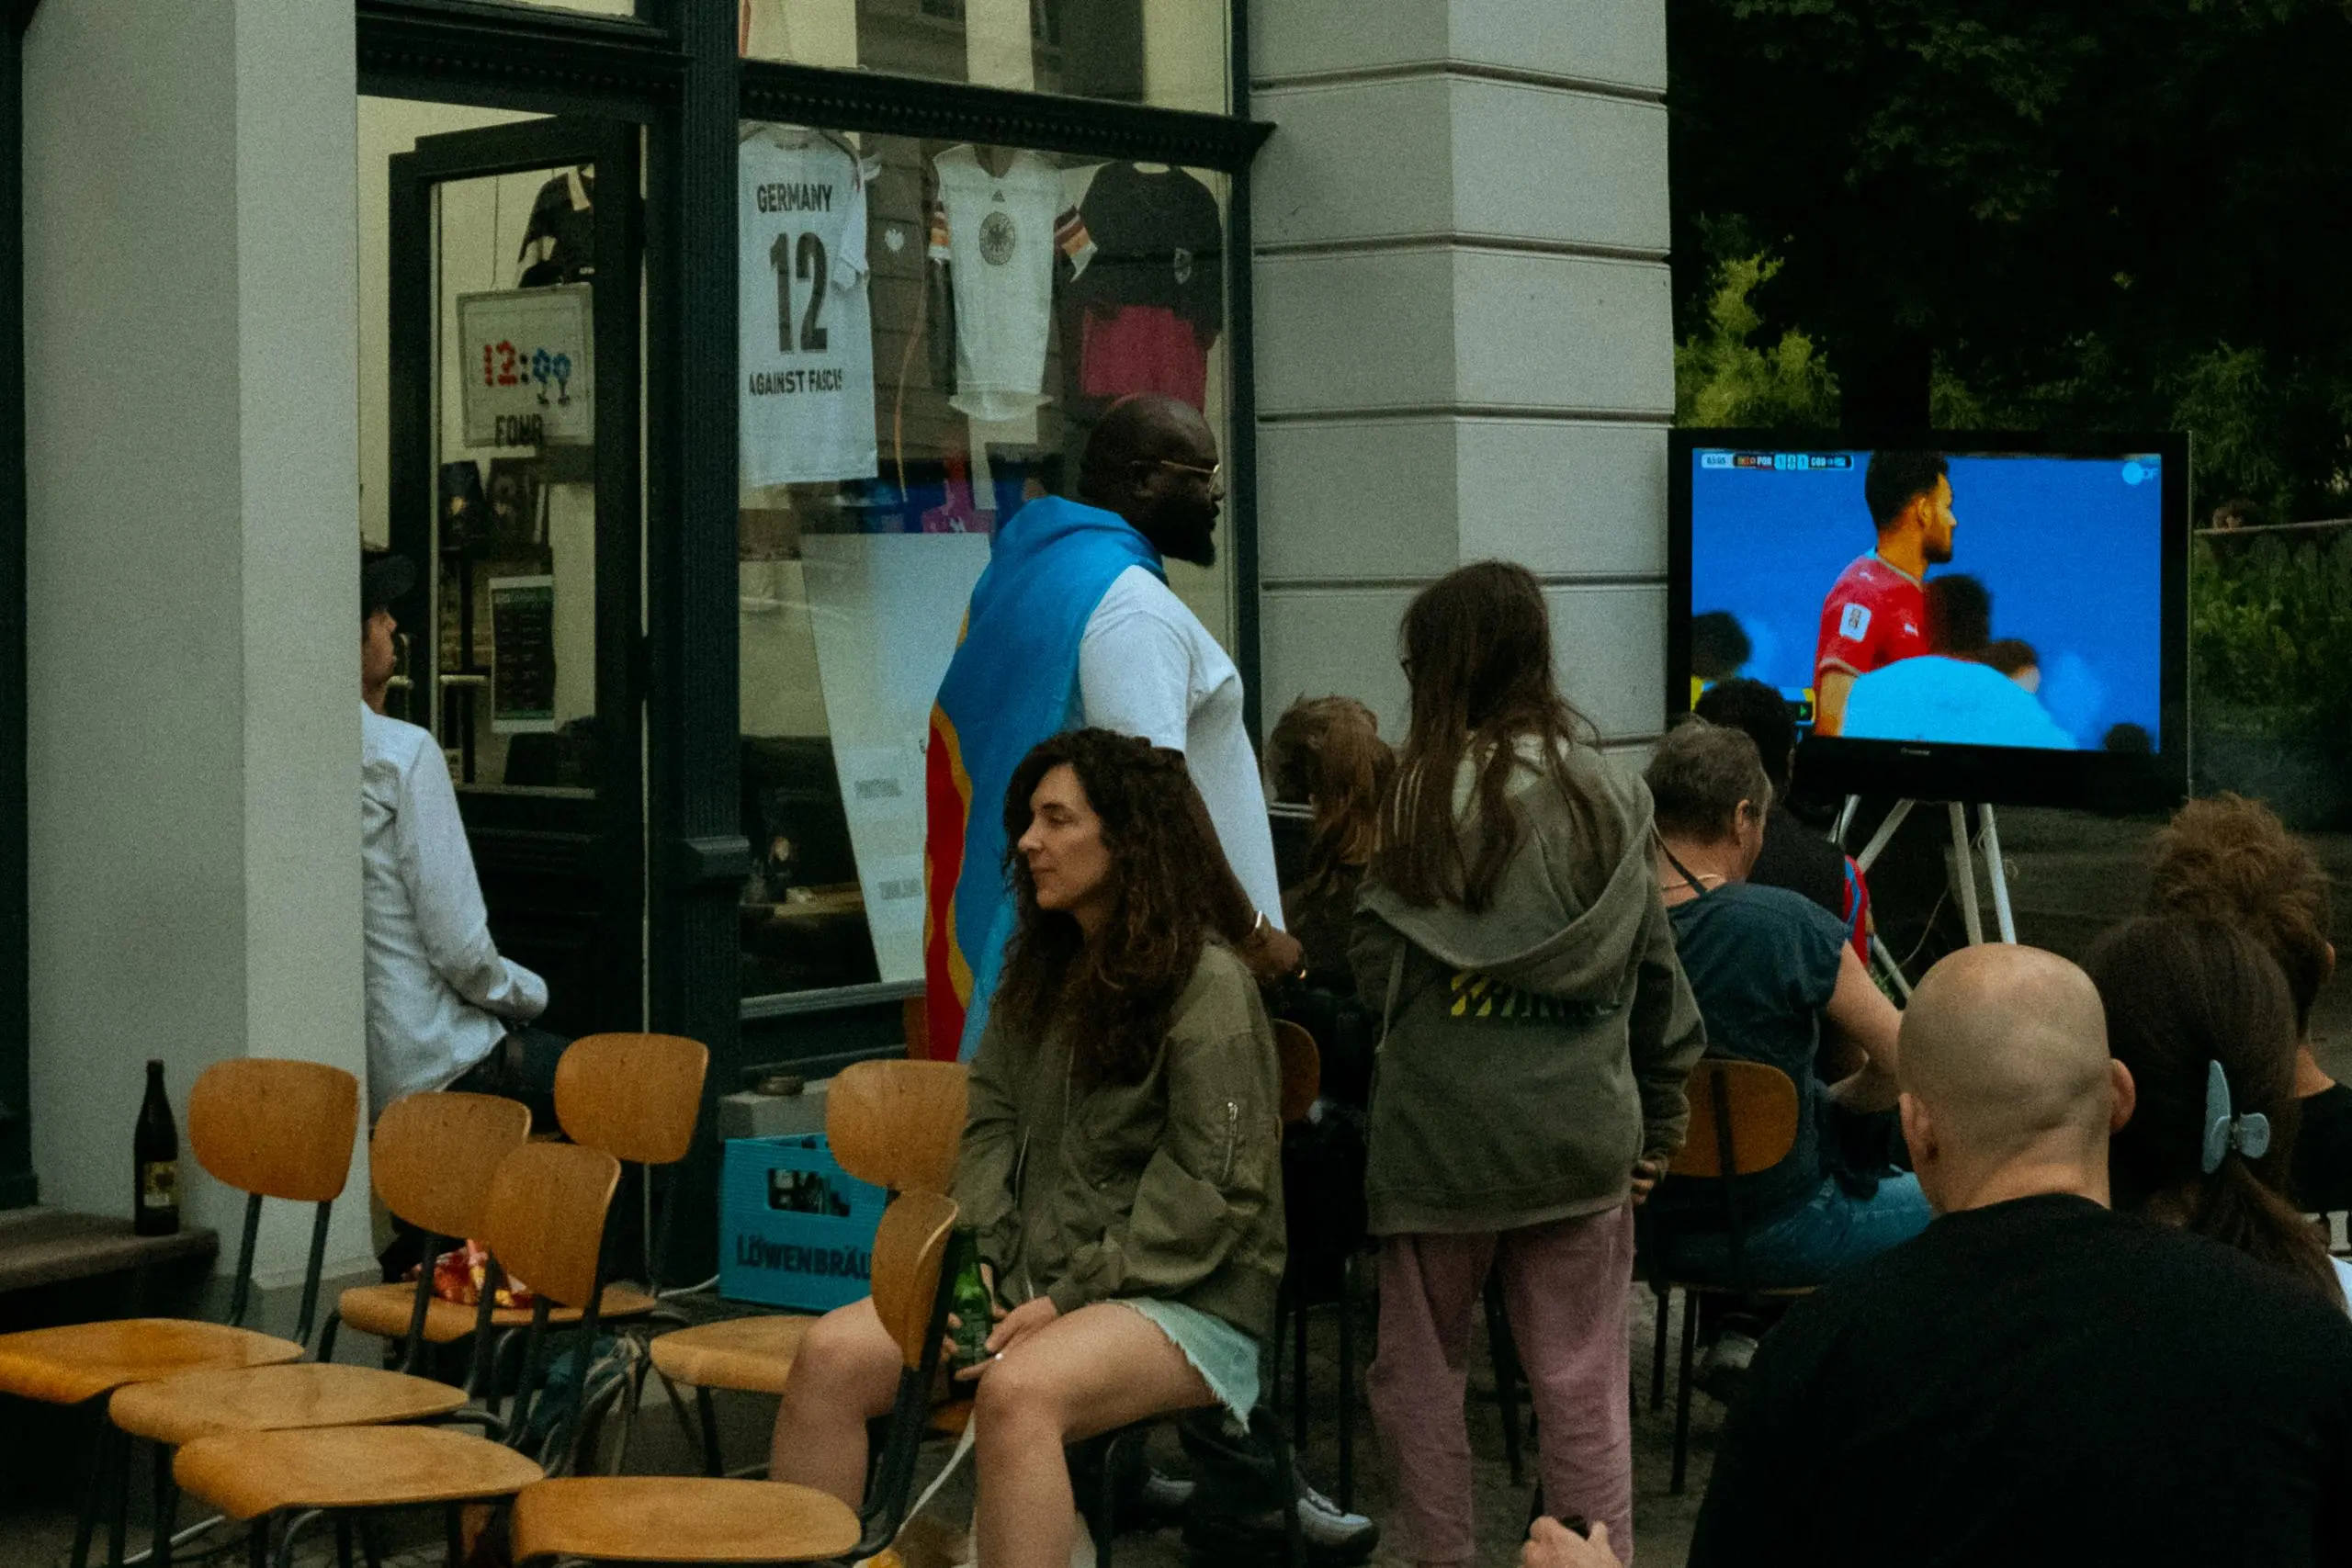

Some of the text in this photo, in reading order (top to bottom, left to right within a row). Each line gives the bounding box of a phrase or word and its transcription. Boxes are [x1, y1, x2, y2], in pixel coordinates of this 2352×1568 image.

[756, 183, 832, 214] GERMANY
[769, 231, 828, 355] 12
[749, 369, 805, 396] AGAINST
